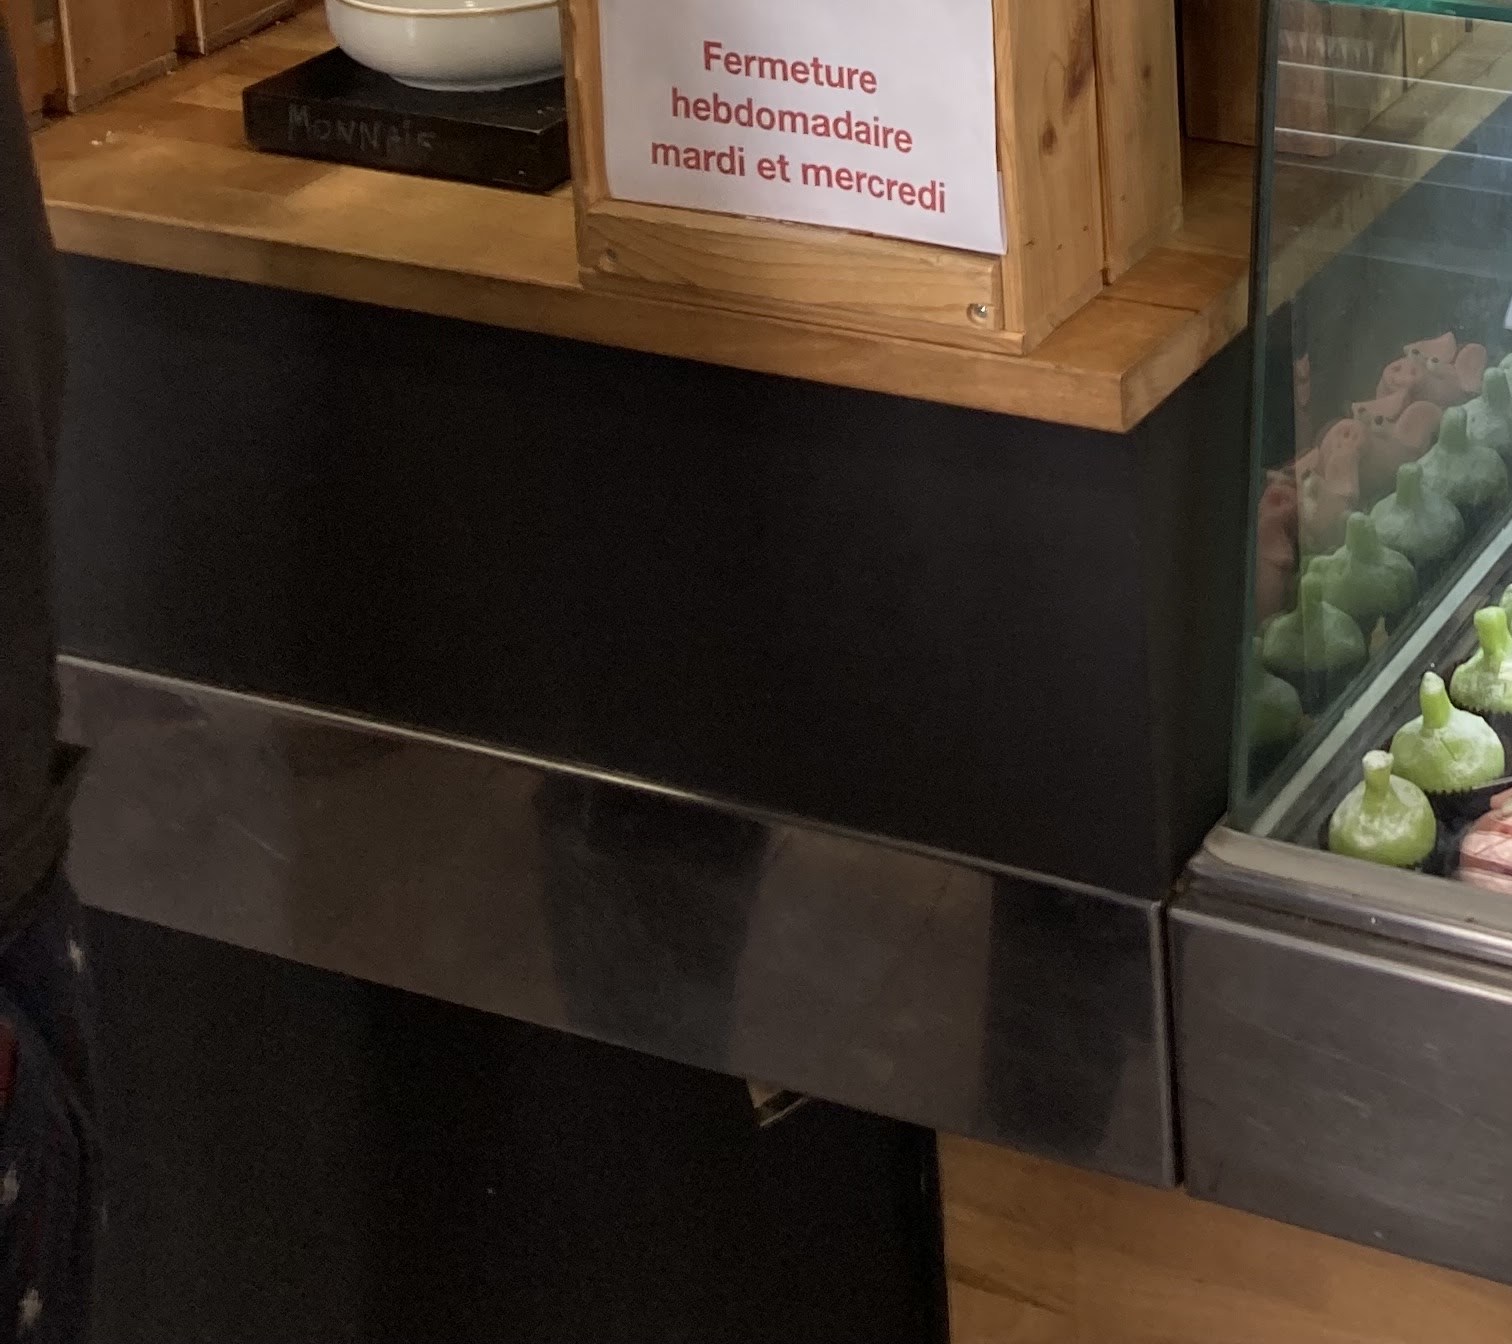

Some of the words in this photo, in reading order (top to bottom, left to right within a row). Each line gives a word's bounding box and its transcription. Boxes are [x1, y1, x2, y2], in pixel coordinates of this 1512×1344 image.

[703, 40, 877, 94] Fermeture
[671, 87, 913, 153] hebdomadaire
[651, 142, 745, 176] mardi
[757, 154, 791, 182] et
[801, 160, 946, 213] mercredi
